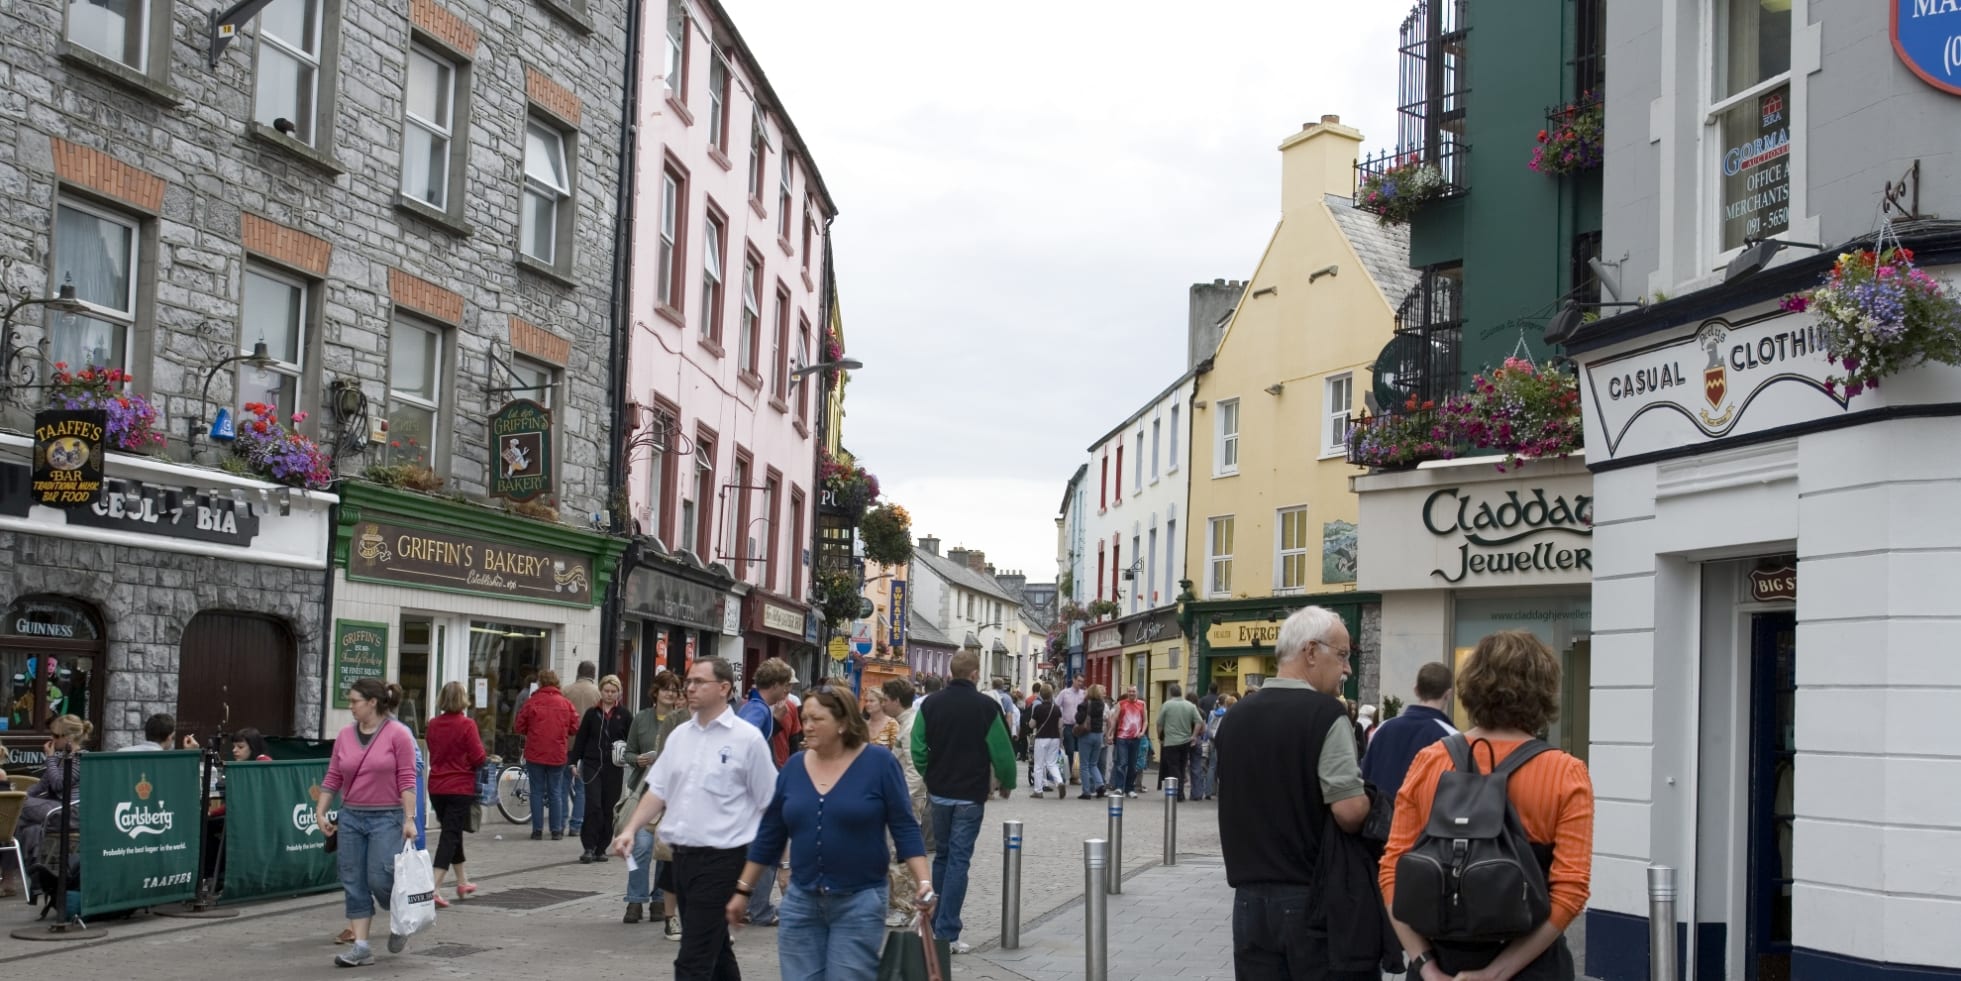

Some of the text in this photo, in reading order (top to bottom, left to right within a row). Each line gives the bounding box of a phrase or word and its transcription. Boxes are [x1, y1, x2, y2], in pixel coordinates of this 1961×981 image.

[1912, 0, 1961, 18] MA
[1762, 111, 1783, 128] ERA
[1723, 127, 1790, 177] GORMA
[1746, 164, 1781, 192] OFFICE
[1725, 184, 1789, 221] MERCHANTS
[1746, 217, 1761, 236] 091
[1768, 207, 1790, 229] 5650
[1608, 361, 1686, 401] CASUAL
[36, 420, 103, 442] TAAFFE'S
[494, 414, 549, 435] GRIFFIN'S
[50, 470, 82, 481] BAR
[497, 476, 548, 493] BAKERY
[42, 491, 90, 502] BAR FOOD
[397, 534, 550, 577] GRIFFIN'S BAKERY
[1430, 541, 1593, 583] Jeweller
[1758, 575, 1797, 593] BIG S
[893, 586, 904, 640] SWEATERS
[16, 617, 73, 638] GUINNESS
[343, 631, 382, 647] GRIFFIN'S
[9, 748, 48, 764] GUINN
[114, 800, 173, 836] Carlsberg
[102, 848, 126, 857] Probably
[134, 846, 145, 854] best
[145, 845, 159, 853] lager
[143, 872, 192, 889] TAAFFES
